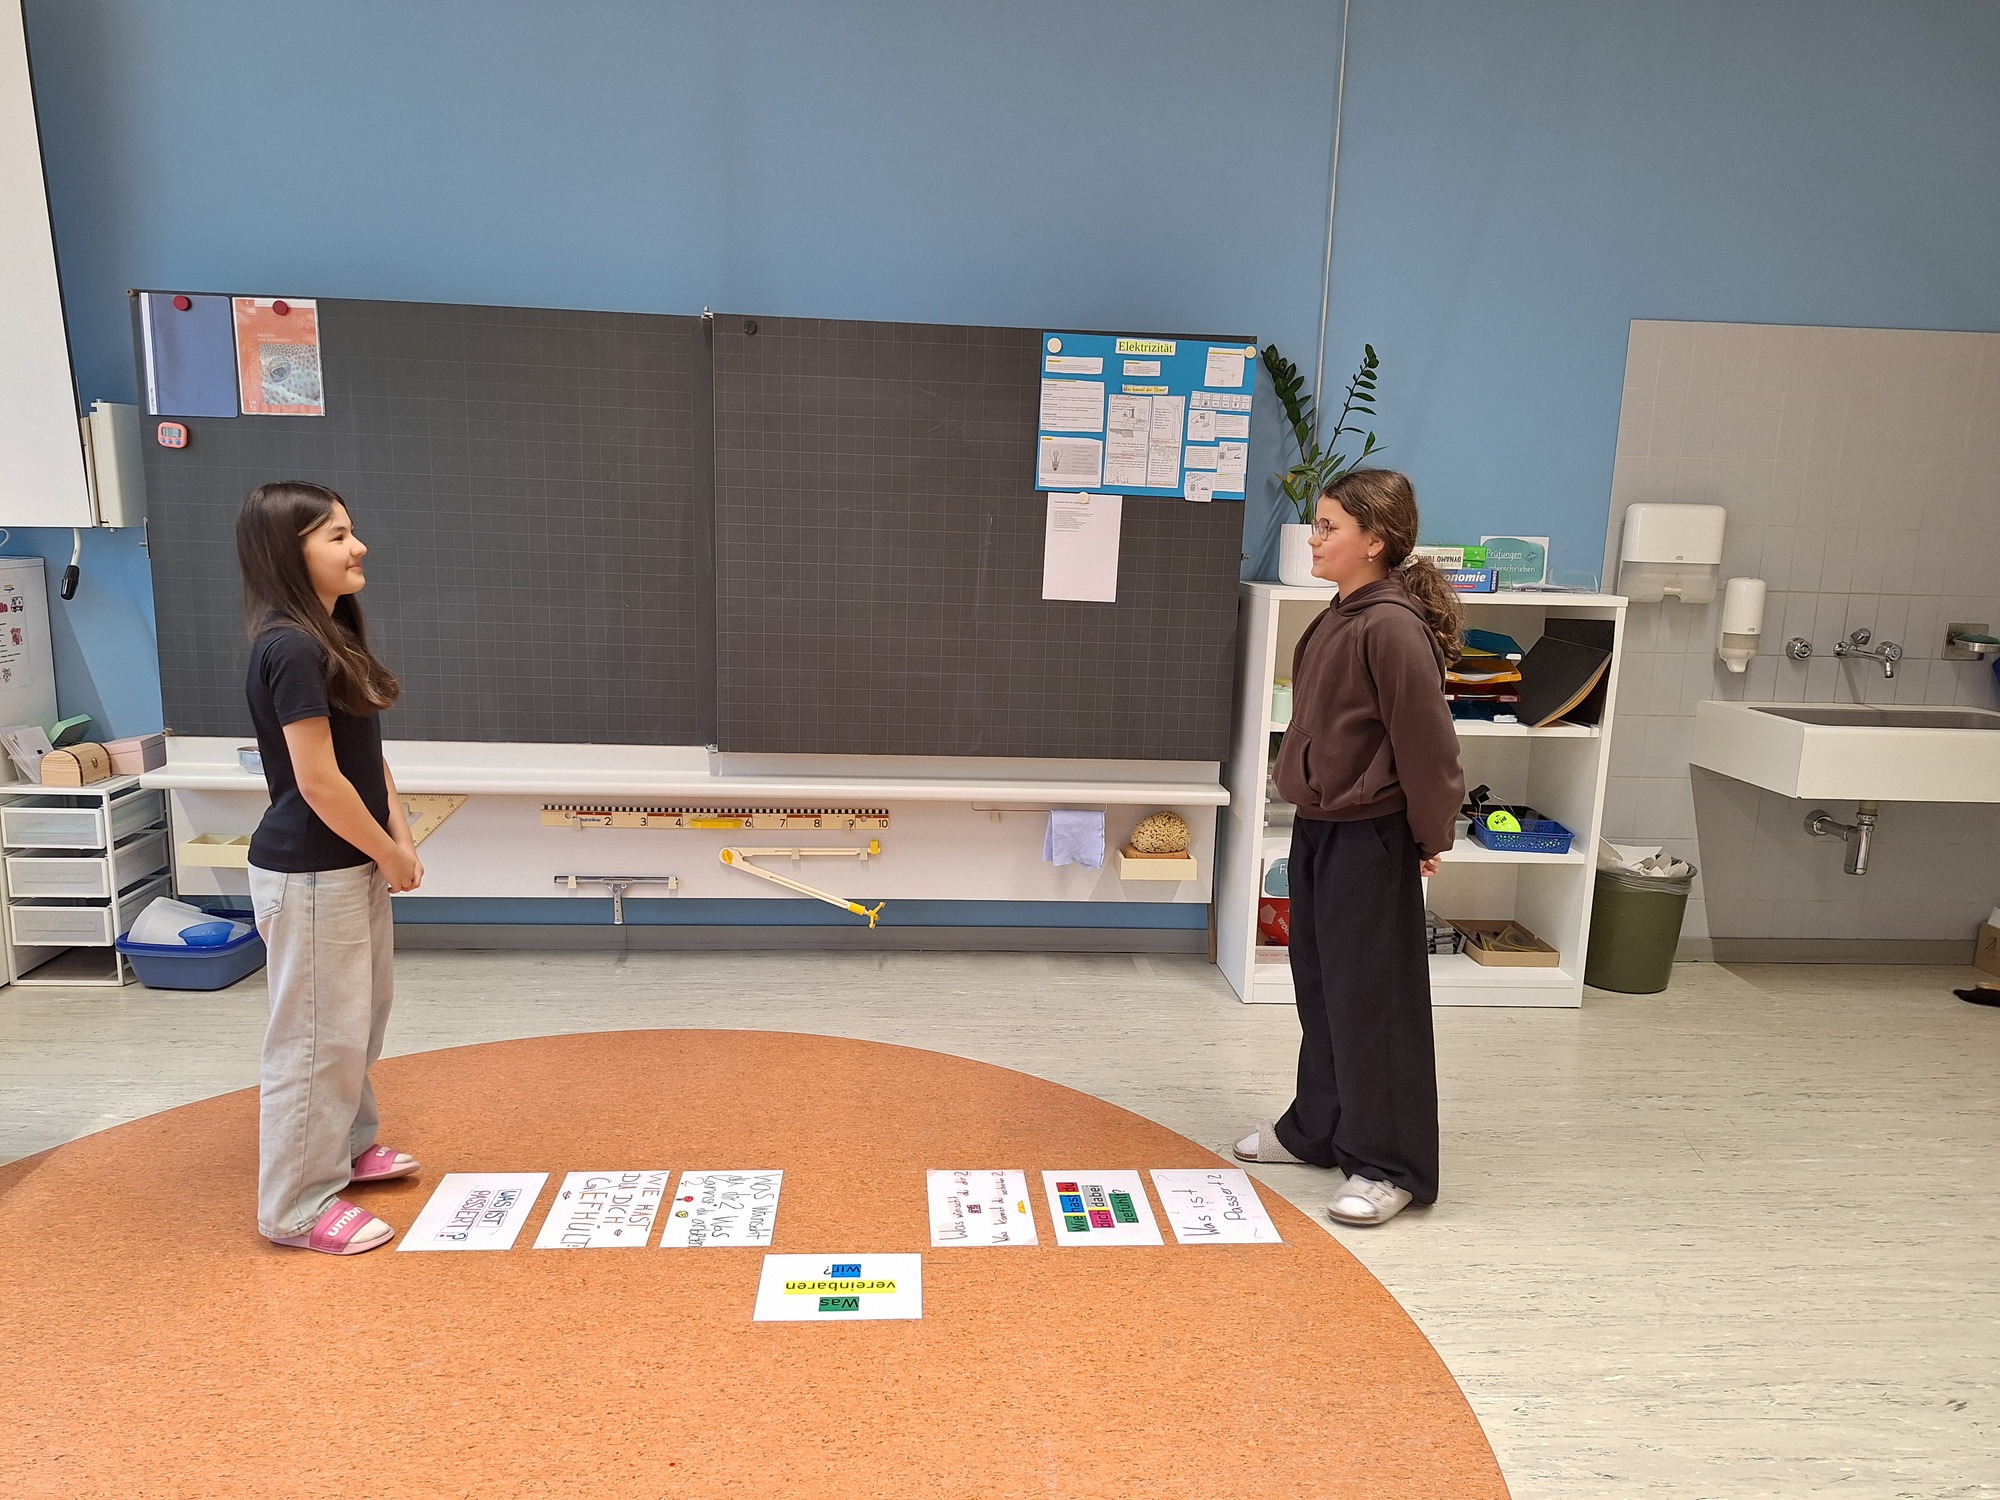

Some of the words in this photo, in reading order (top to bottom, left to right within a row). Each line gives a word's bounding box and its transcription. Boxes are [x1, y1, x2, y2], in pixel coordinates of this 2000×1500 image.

[1118, 341, 1173, 353] Elektrizität
[1436, 555, 1461, 563] DYNAMO
[1486, 548, 1522, 562] Prüfungen
[604, 816, 612, 826] 2
[640, 817, 647, 827] 3
[675, 818, 682, 827] 4
[744, 818, 752, 827] 6
[779, 819, 786, 828] 7
[813, 819, 821, 828] 8
[848, 819, 855, 828] 9
[878, 819, 889, 828] 10
[618, 1173, 642, 1190] DU
[641, 1172, 667, 1197] WIE
[1062, 1182, 1076, 1192] du
[493, 1190, 518, 1208] WAS
[1067, 1194, 1081, 1213] hast
[1085, 1184, 1106, 1208] dabei
[1171, 1189, 1206, 1208] ist
[481, 1209, 506, 1226] IST
[602, 1194, 634, 1224] DICH
[627, 1204, 655, 1232] HAST
[938, 1220, 968, 1241] Was
[956, 1189, 970, 1197] du
[327, 1206, 365, 1237] umbr
[1071, 1215, 1087, 1232] Wie
[1094, 1210, 1111, 1228] dich
[1182, 1214, 1221, 1237] Was
[785, 1281, 897, 1292] vereinbaren
[819, 1298, 860, 1309] Was
